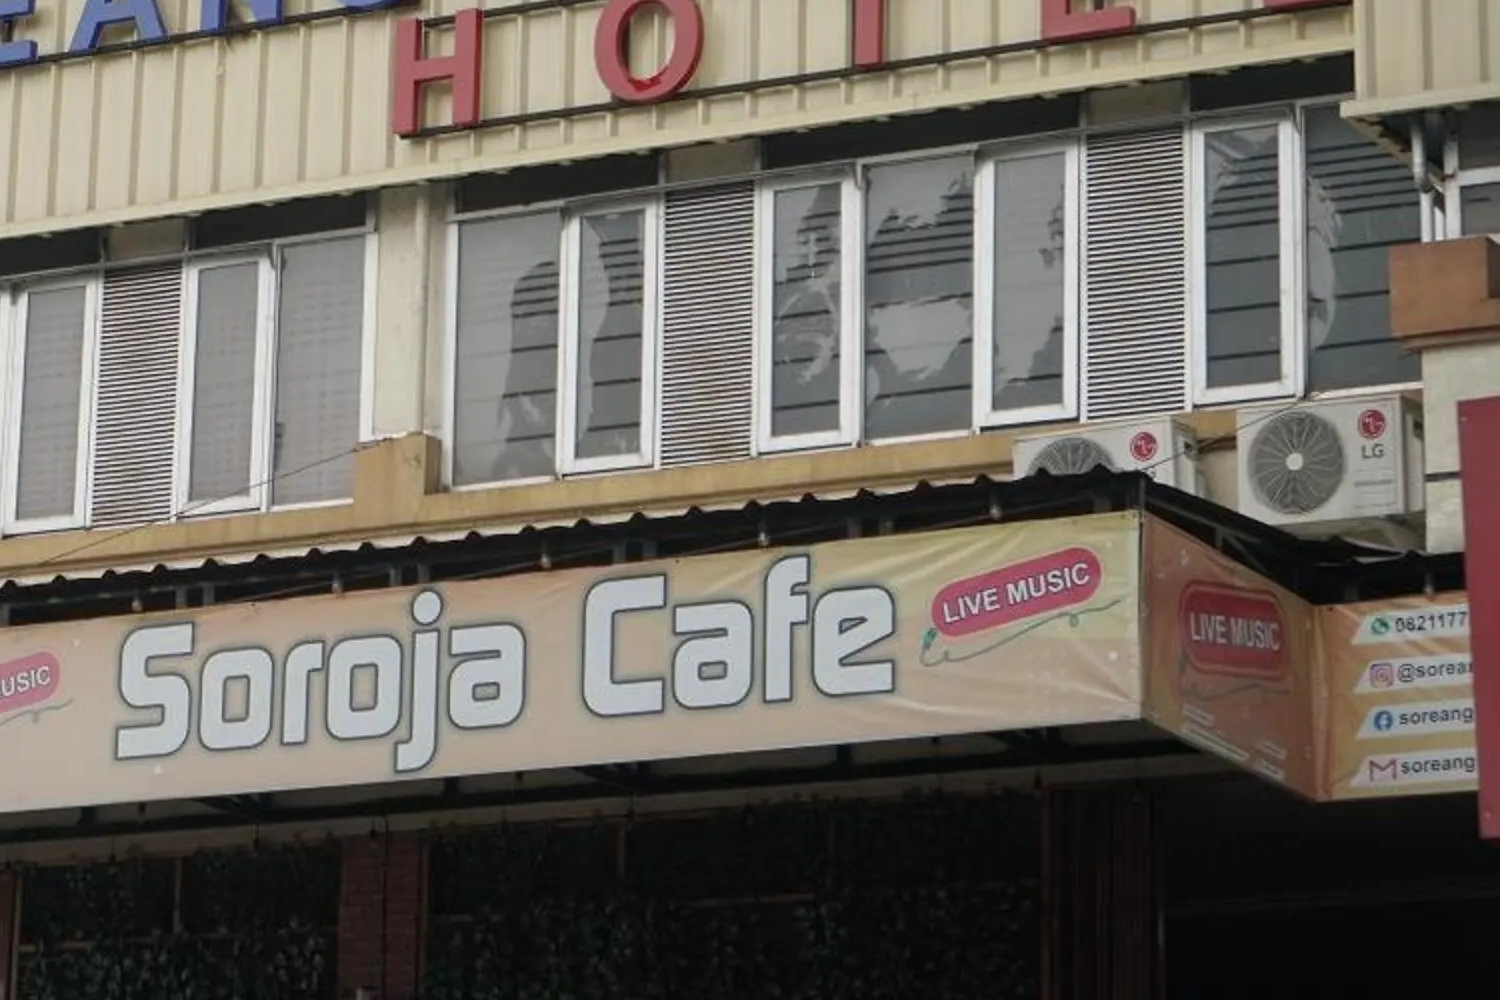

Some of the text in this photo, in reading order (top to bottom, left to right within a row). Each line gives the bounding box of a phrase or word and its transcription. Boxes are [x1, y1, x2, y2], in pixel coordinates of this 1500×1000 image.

[1361, 443, 1384, 459] LG
[943, 563, 1090, 623] LIVE MUSIC
[1189, 612, 1279, 650] LIVE MUSIC
[115, 553, 898, 774] Soroja Cafe
[1399, 707, 1474, 725] soreang
[1400, 756, 1476, 775] soreang
